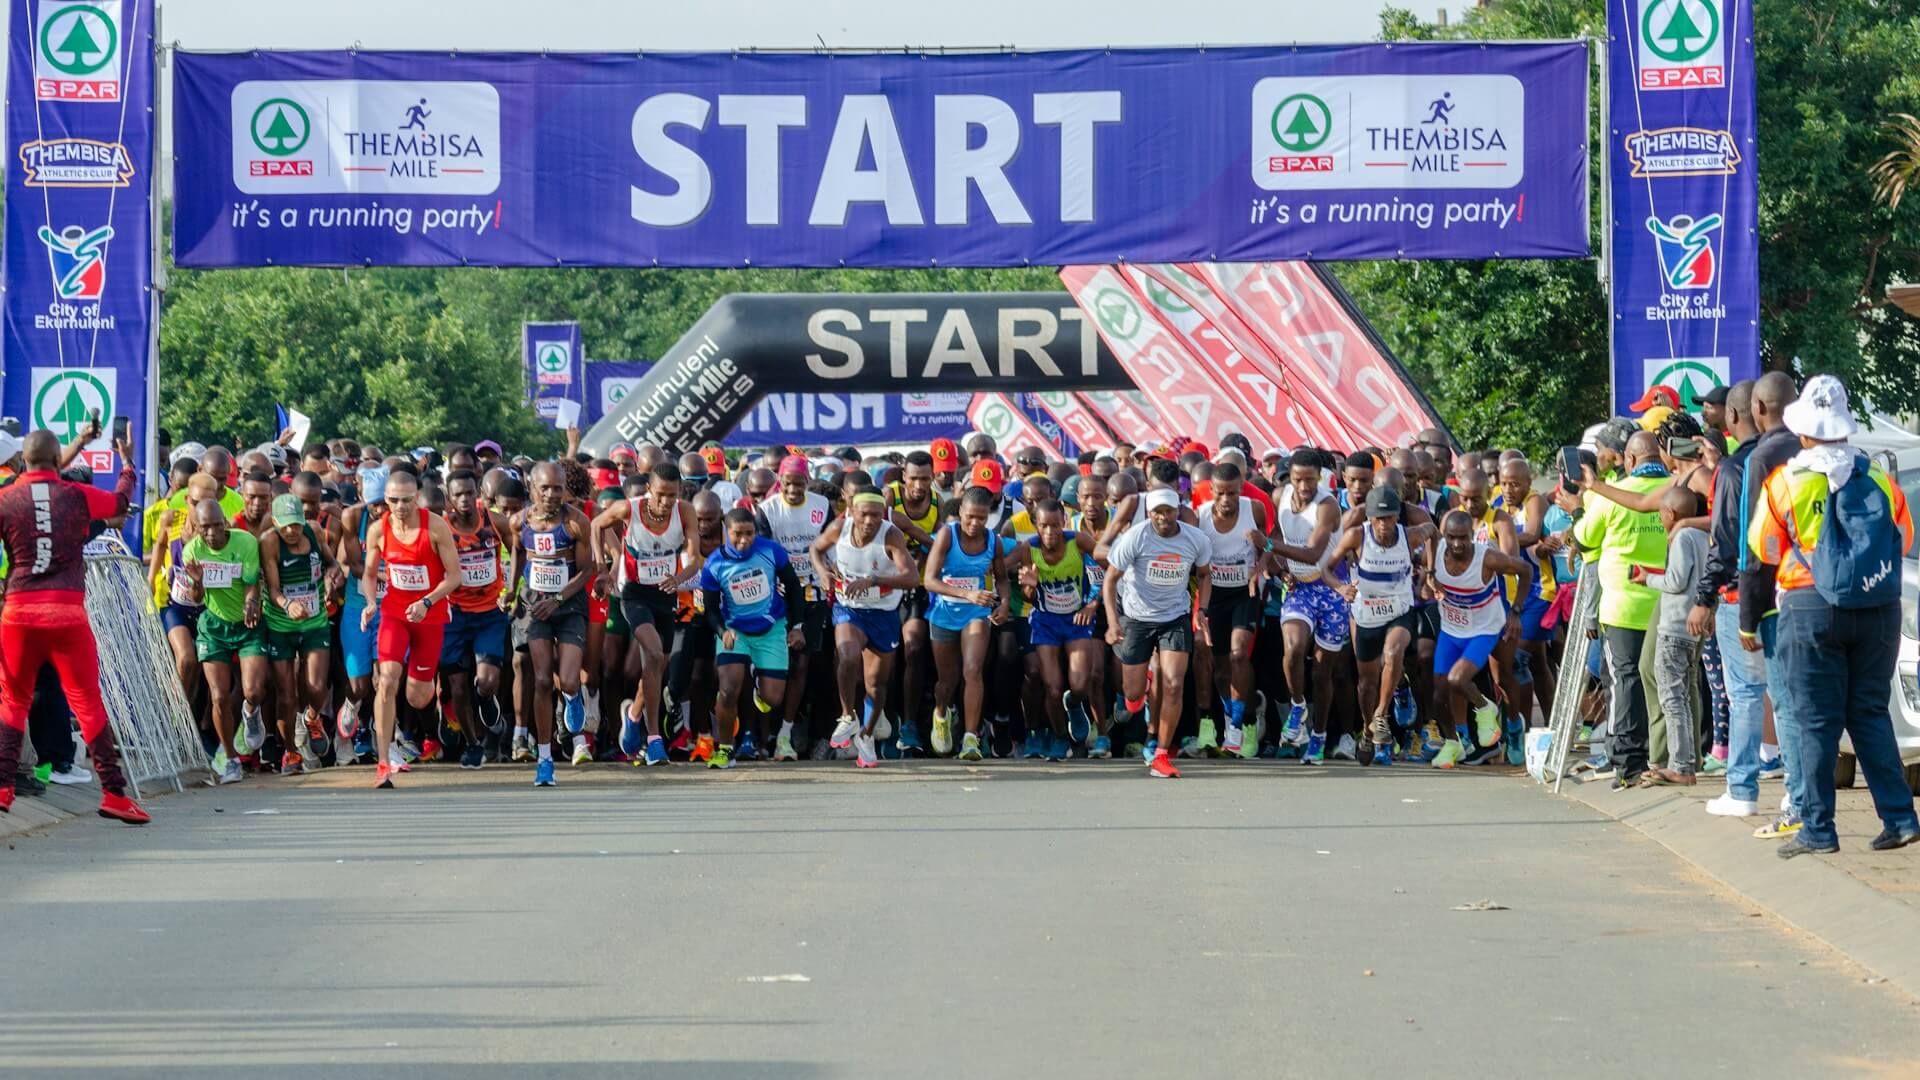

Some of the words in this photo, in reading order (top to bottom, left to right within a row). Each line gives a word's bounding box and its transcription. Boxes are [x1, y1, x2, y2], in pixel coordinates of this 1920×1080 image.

[1642, 68, 1722, 86] SPAR
[39, 81, 118, 98] SPAR
[344, 132, 484, 157] THEMBISA
[1366, 127, 1507, 151] THEMBISA
[1631, 131, 1735, 158] THEMBISA
[25, 143, 128, 169] THEMBISA
[631, 91, 1122, 227] START
[1270, 158, 1332, 170] SPAR
[1412, 154, 1460, 172] MILE
[1648, 157, 1694, 168] ATHLETICS
[1696, 156, 1721, 167] CLUB
[41, 169, 88, 178] ATHLETICS
[90, 169, 113, 178] CLUB
[251, 162, 313, 175] SPAR
[390, 159, 438, 178] MILE
[232, 200, 270, 227] it's
[280, 210, 298, 227] a
[308, 202, 412, 233] running
[422, 200, 502, 235] party!
[1251, 196, 1289, 224] it's
[1300, 205, 1317, 222] a
[1328, 197, 1434, 229] running
[1444, 194, 1525, 229] party!
[1660, 293, 1688, 309] City
[1692, 292, 1710, 307] of
[49, 303, 80, 319] City
[82, 303, 99, 315] of
[1646, 305, 1726, 320] Ekurhuleni
[35, 315, 115, 329] Ekurhuleni
[805, 308, 1098, 378] START
[615, 334, 720, 441] Ekurhuleni
[689, 357, 738, 404] Mile
[669, 373, 755, 457] ERIES
[918, 416, 927, 424] a
[928, 414, 965, 425] running
[811, 510, 824, 523] 60
[537, 538, 552, 551] 50
[468, 569, 490, 581] 1425
[535, 573, 562, 585] SIPHO
[1210, 571, 1246, 582] SAMUEL
[739, 583, 762, 599] 1307
[1370, 604, 1394, 616] 1494
